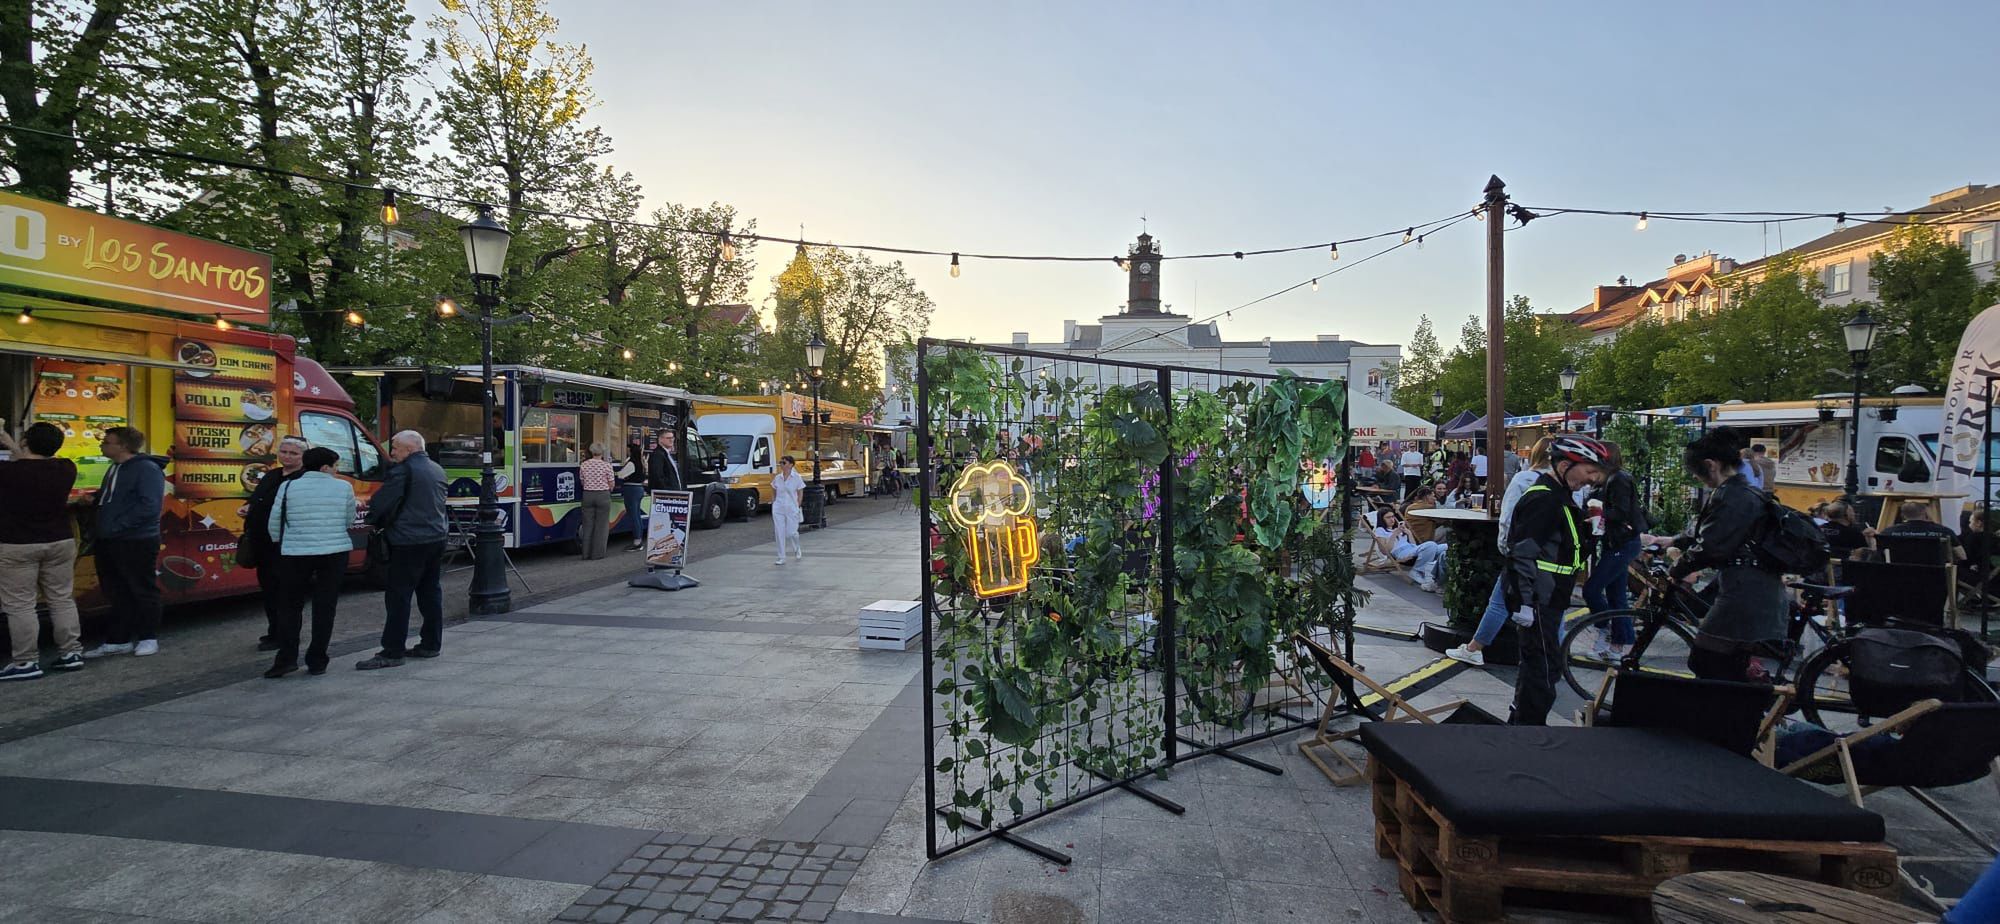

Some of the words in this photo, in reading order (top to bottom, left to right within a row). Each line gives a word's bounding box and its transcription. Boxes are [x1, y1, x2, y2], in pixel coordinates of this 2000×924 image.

[58, 235, 82, 248] BY
[219, 357, 240, 367] CON
[242, 360, 273, 371] CARNE
[185, 393, 231, 408] POLLO
[186, 426, 231, 437] TAJSKI
[1408, 427, 1428, 437] TYSKIE
[187, 436, 230, 448] WRAP
[182, 473, 236, 483] MASALA
[655, 504, 689, 514] Churros
[1859, 871, 1888, 884] EPAL
